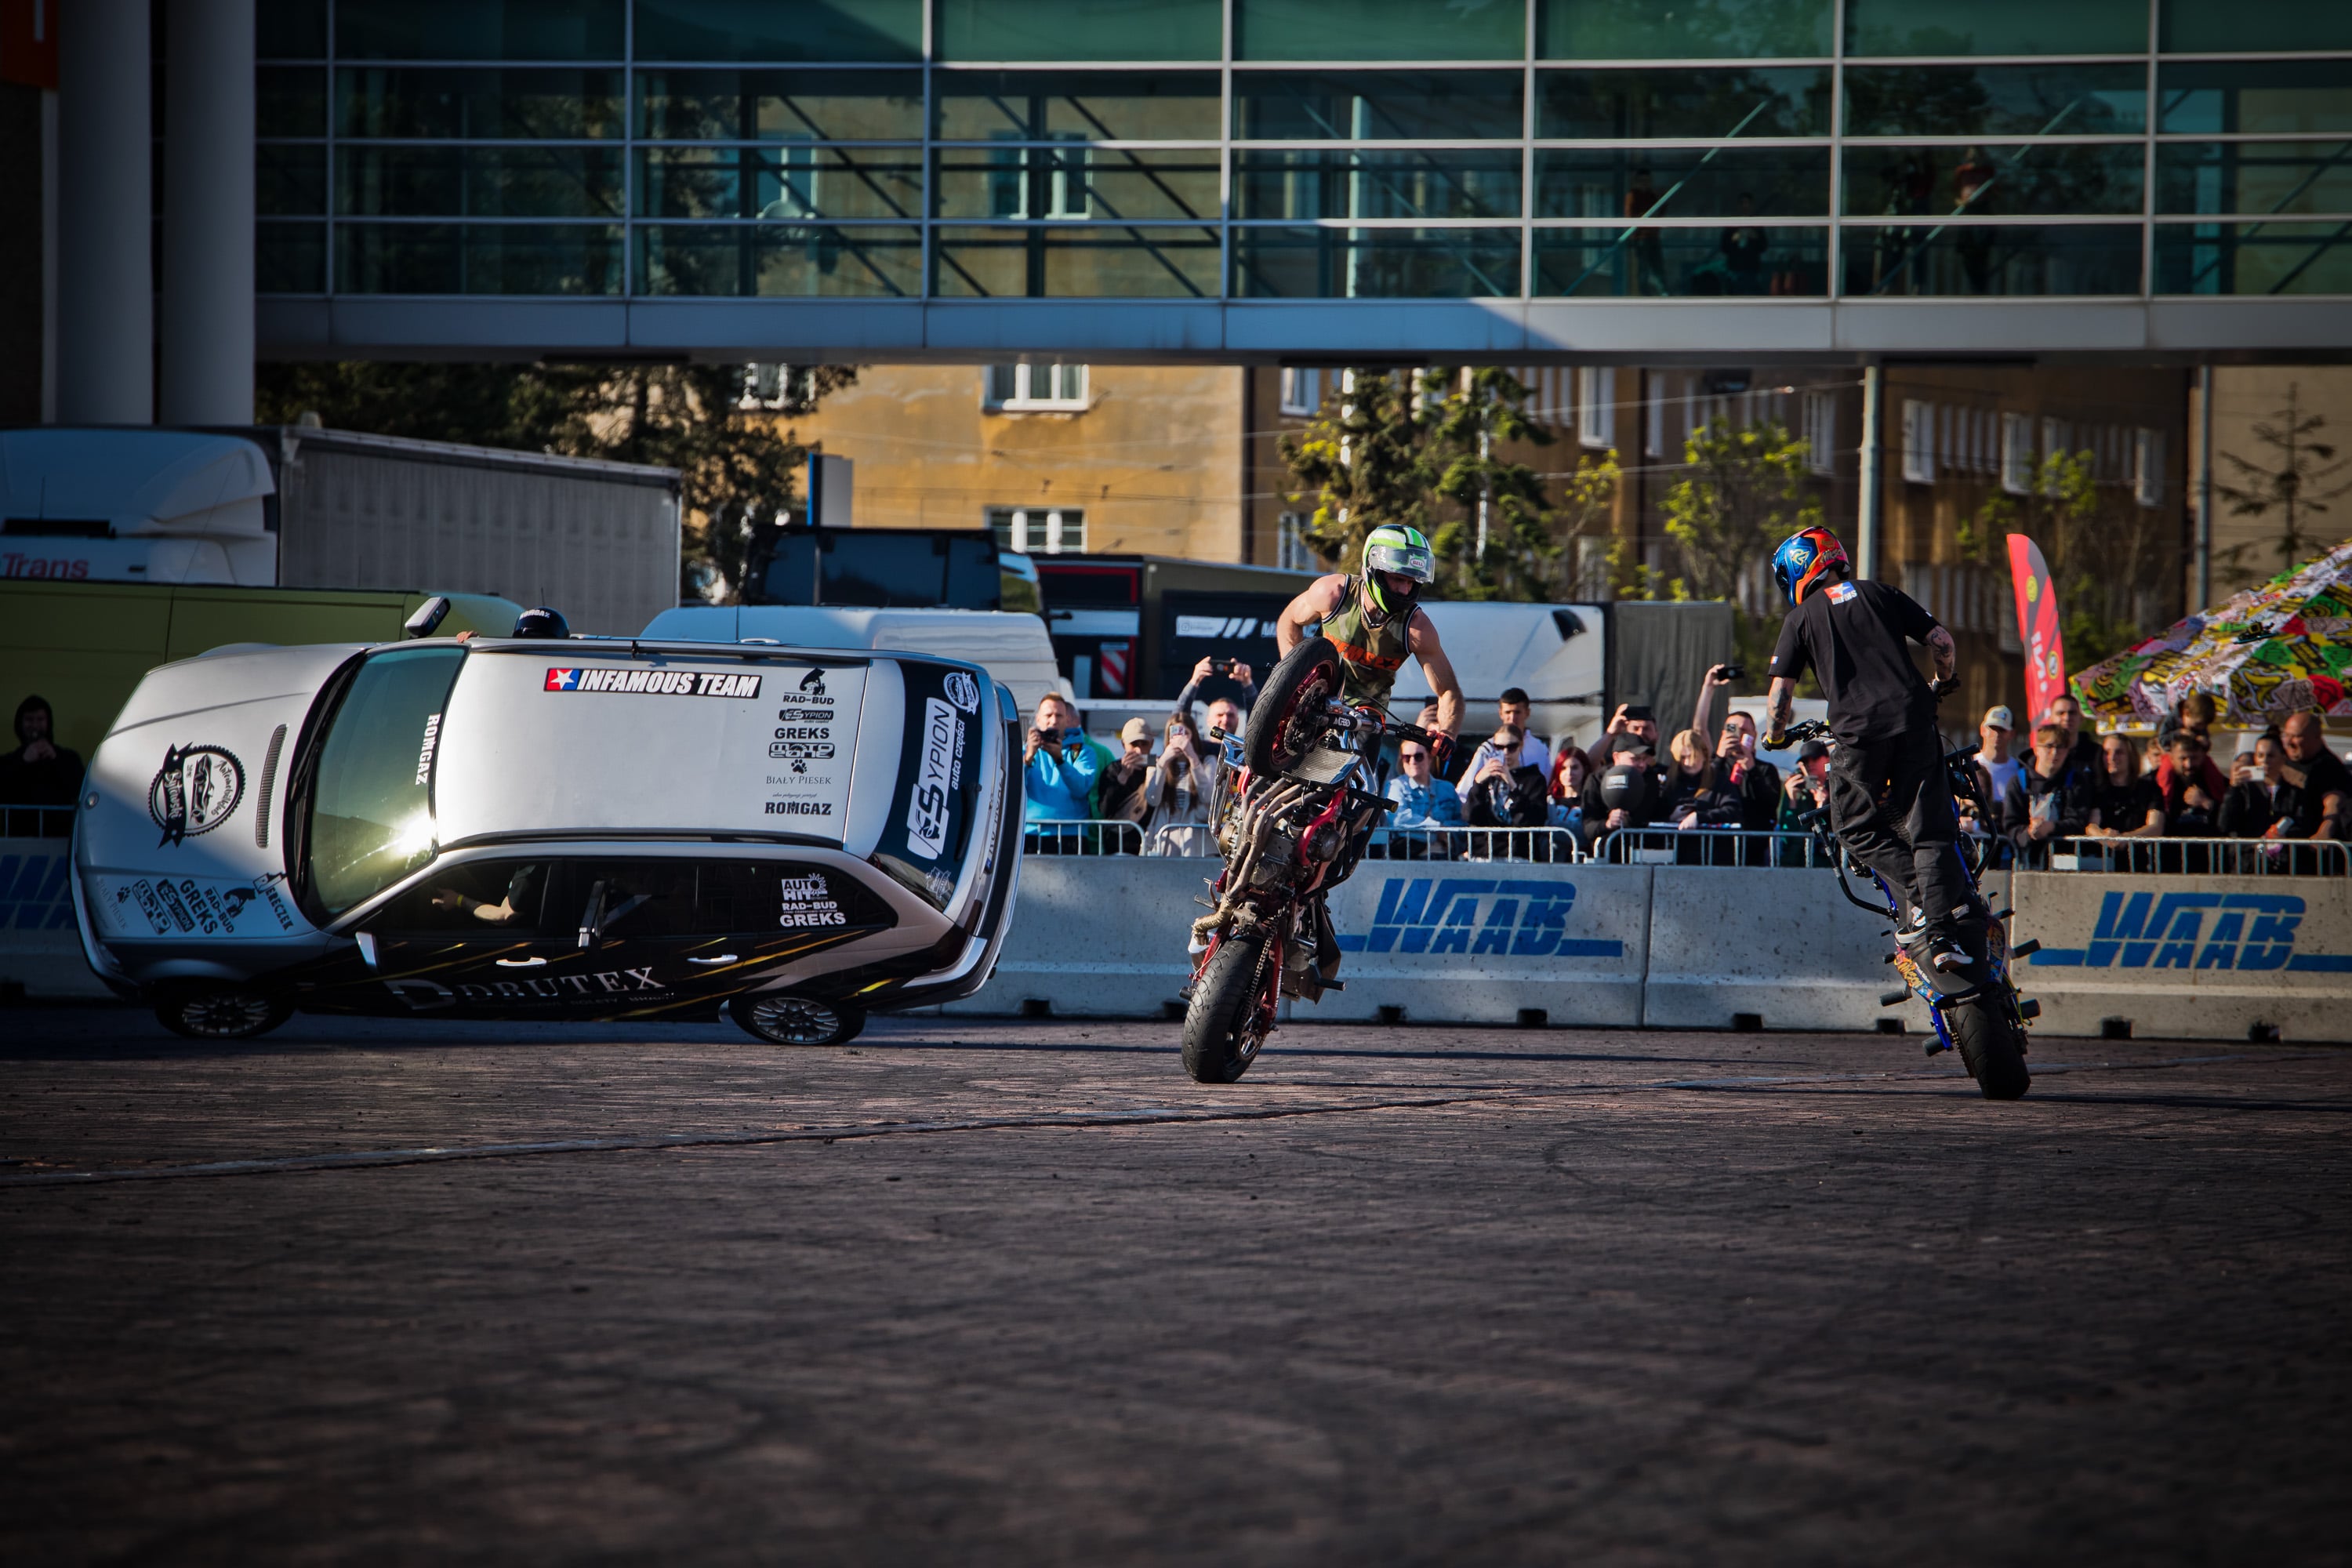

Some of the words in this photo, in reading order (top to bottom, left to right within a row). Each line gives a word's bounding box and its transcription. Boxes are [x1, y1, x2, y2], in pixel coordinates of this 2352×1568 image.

[2, 552, 89, 579] Trans
[577, 670, 693, 695] INFAMOUS
[696, 673, 759, 698] TEAM
[782, 695, 835, 705] RAD-BUD
[774, 728, 829, 739] GREKS
[955, 720, 966, 758] części
[415, 713, 442, 786] ROMGAZ
[766, 775, 796, 785] BIAŁY
[798, 776, 833, 785] PIESEK
[951, 761, 962, 791] auto
[764, 800, 832, 815] ROMGAZ
[784, 879, 820, 890] AUTO
[781, 901, 838, 911] RAD-BUD
[782, 891, 811, 901] HIT
[180, 879, 219, 935] GREKS
[204, 888, 234, 933] RAD-BUD
[779, 912, 847, 927] GREKS
[455, 965, 668, 1004] DRUTEX
